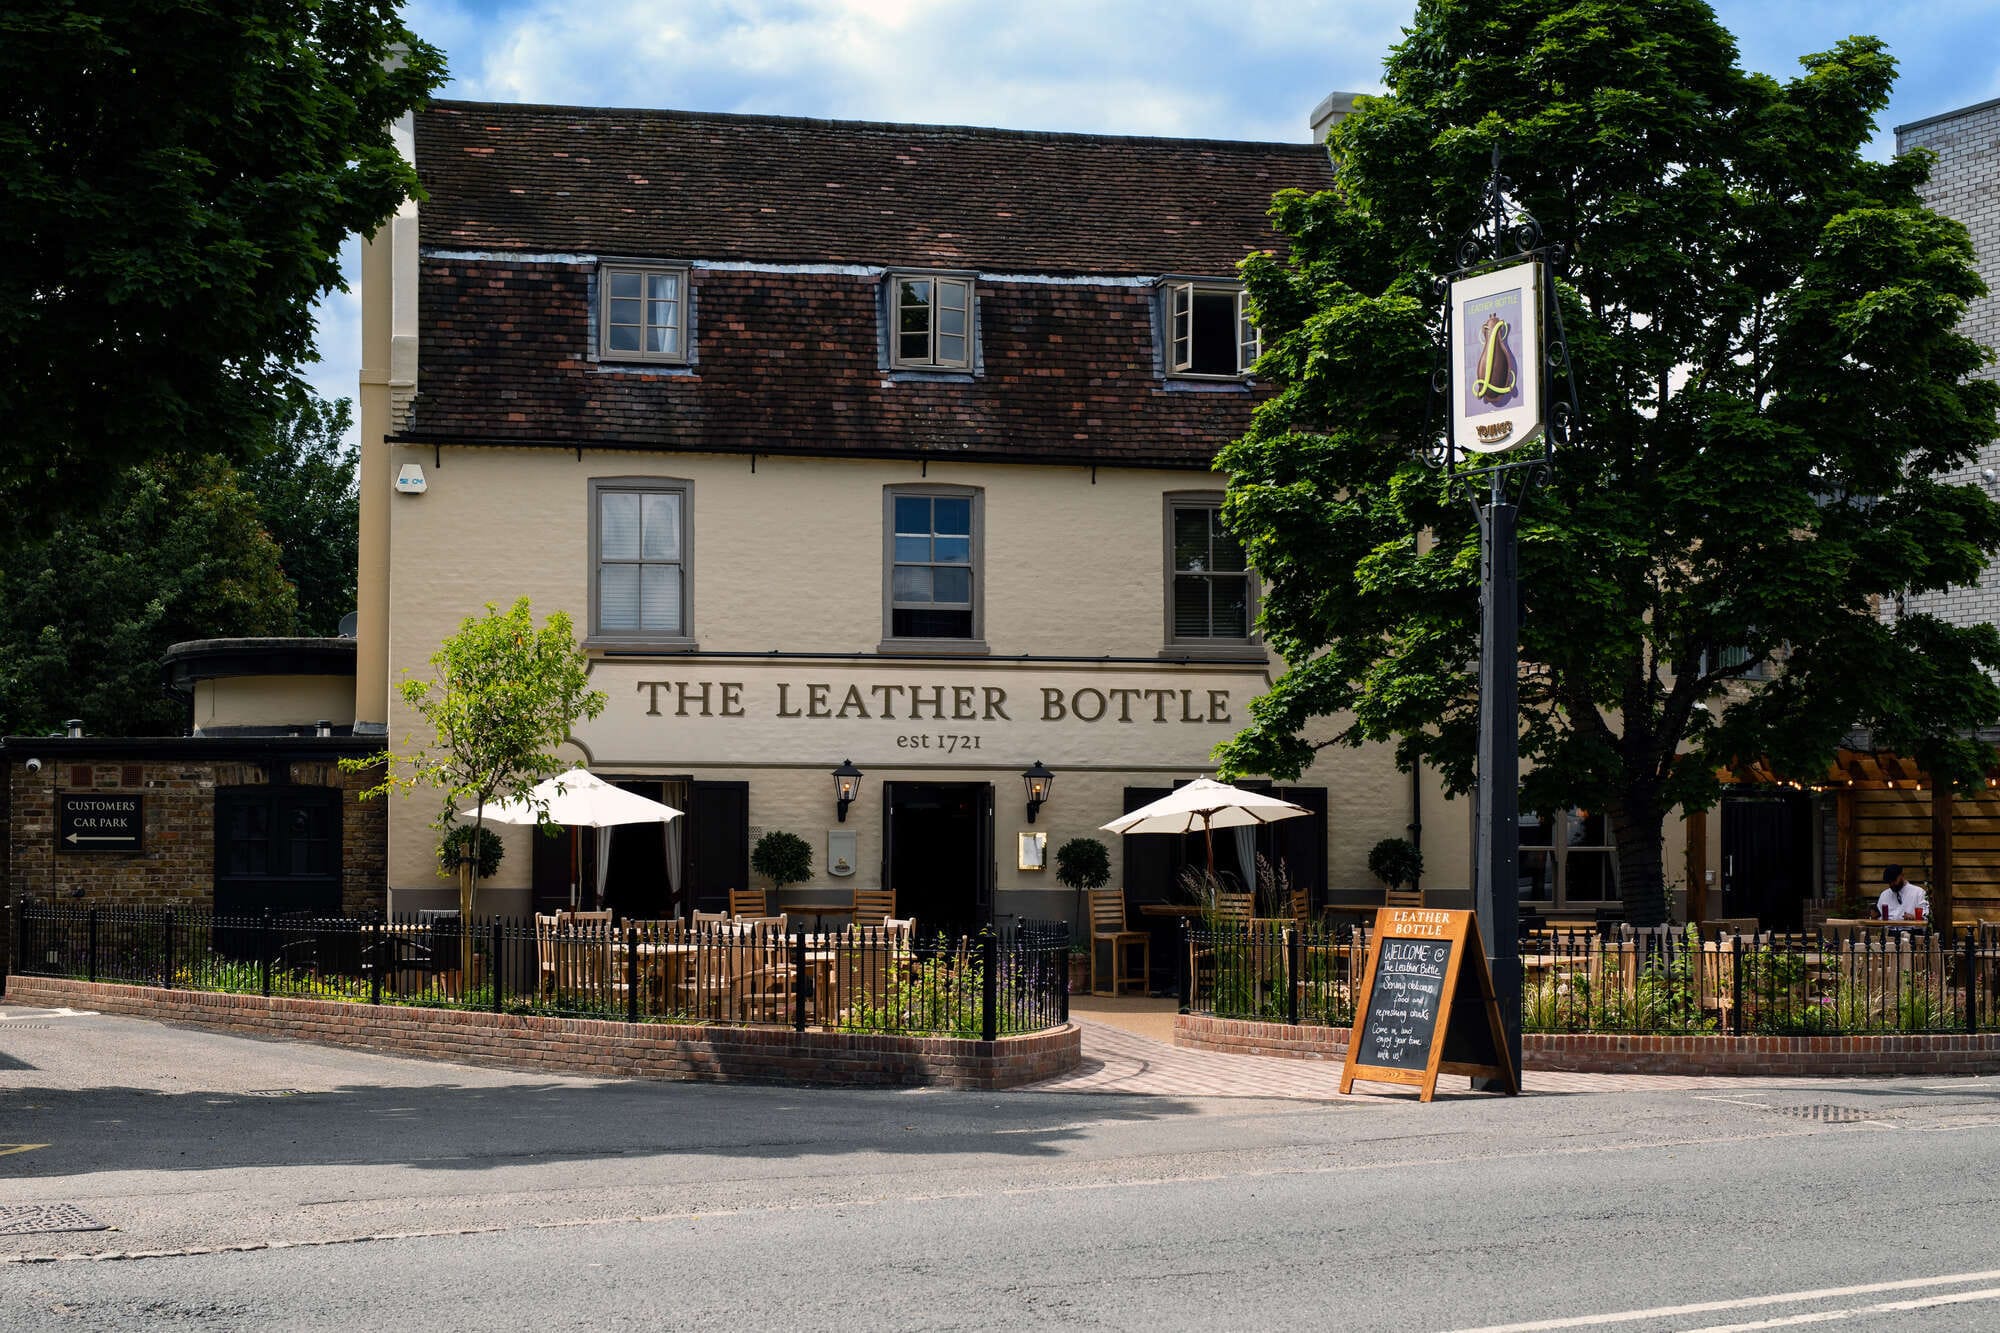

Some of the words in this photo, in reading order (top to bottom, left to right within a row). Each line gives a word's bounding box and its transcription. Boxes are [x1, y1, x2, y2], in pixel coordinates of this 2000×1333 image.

[637, 681, 745, 716] THE
[776, 683, 1011, 721] LEATHER
[1040, 687, 1231, 722] BOTTLE
[896, 733, 929, 748] est
[938, 735, 981, 753] 1721
[67, 801, 135, 811] CUSTOMERS
[73, 817, 97, 827] CAR
[100, 817, 128, 827] PARK
[1394, 911, 1449, 923] LEATHER
[1396, 924, 1442, 936] BOTTLE
[1384, 944, 1430, 961] WELCOME
[1384, 961, 1395, 972] The
[1395, 961, 1420, 973] Leather
[1420, 963, 1440, 975] Bottle
[1393, 993, 1410, 1009] food
[1412, 995, 1425, 1006] and
[1372, 1022, 1388, 1034] Come
[1375, 1035, 1392, 1048] enjoy
[1393, 1036, 1407, 1048] your
